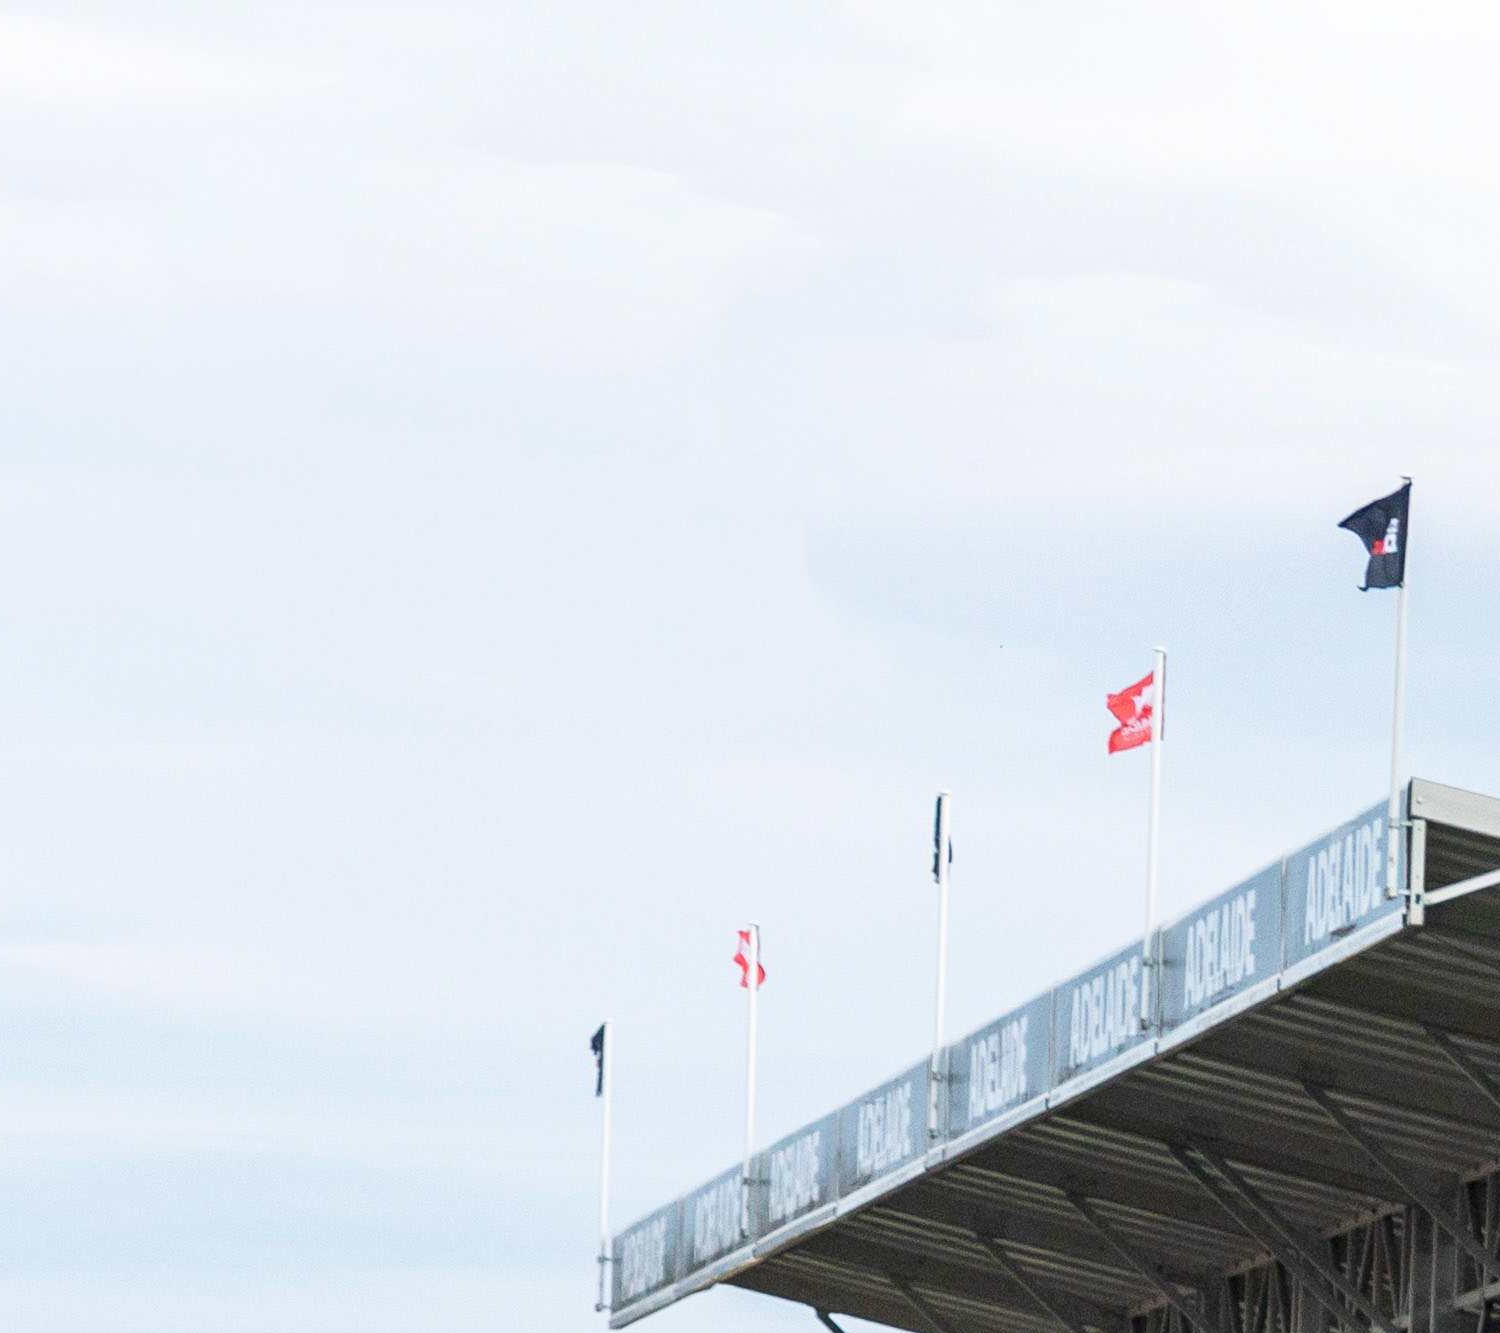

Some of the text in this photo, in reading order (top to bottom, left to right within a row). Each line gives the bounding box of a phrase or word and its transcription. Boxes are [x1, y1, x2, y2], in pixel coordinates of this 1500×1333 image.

[1304, 817, 1383, 946] ADELAIDE
[1184, 889, 1256, 1010] ADELAIDE
[1069, 954, 1139, 1068] ADELAIDE
